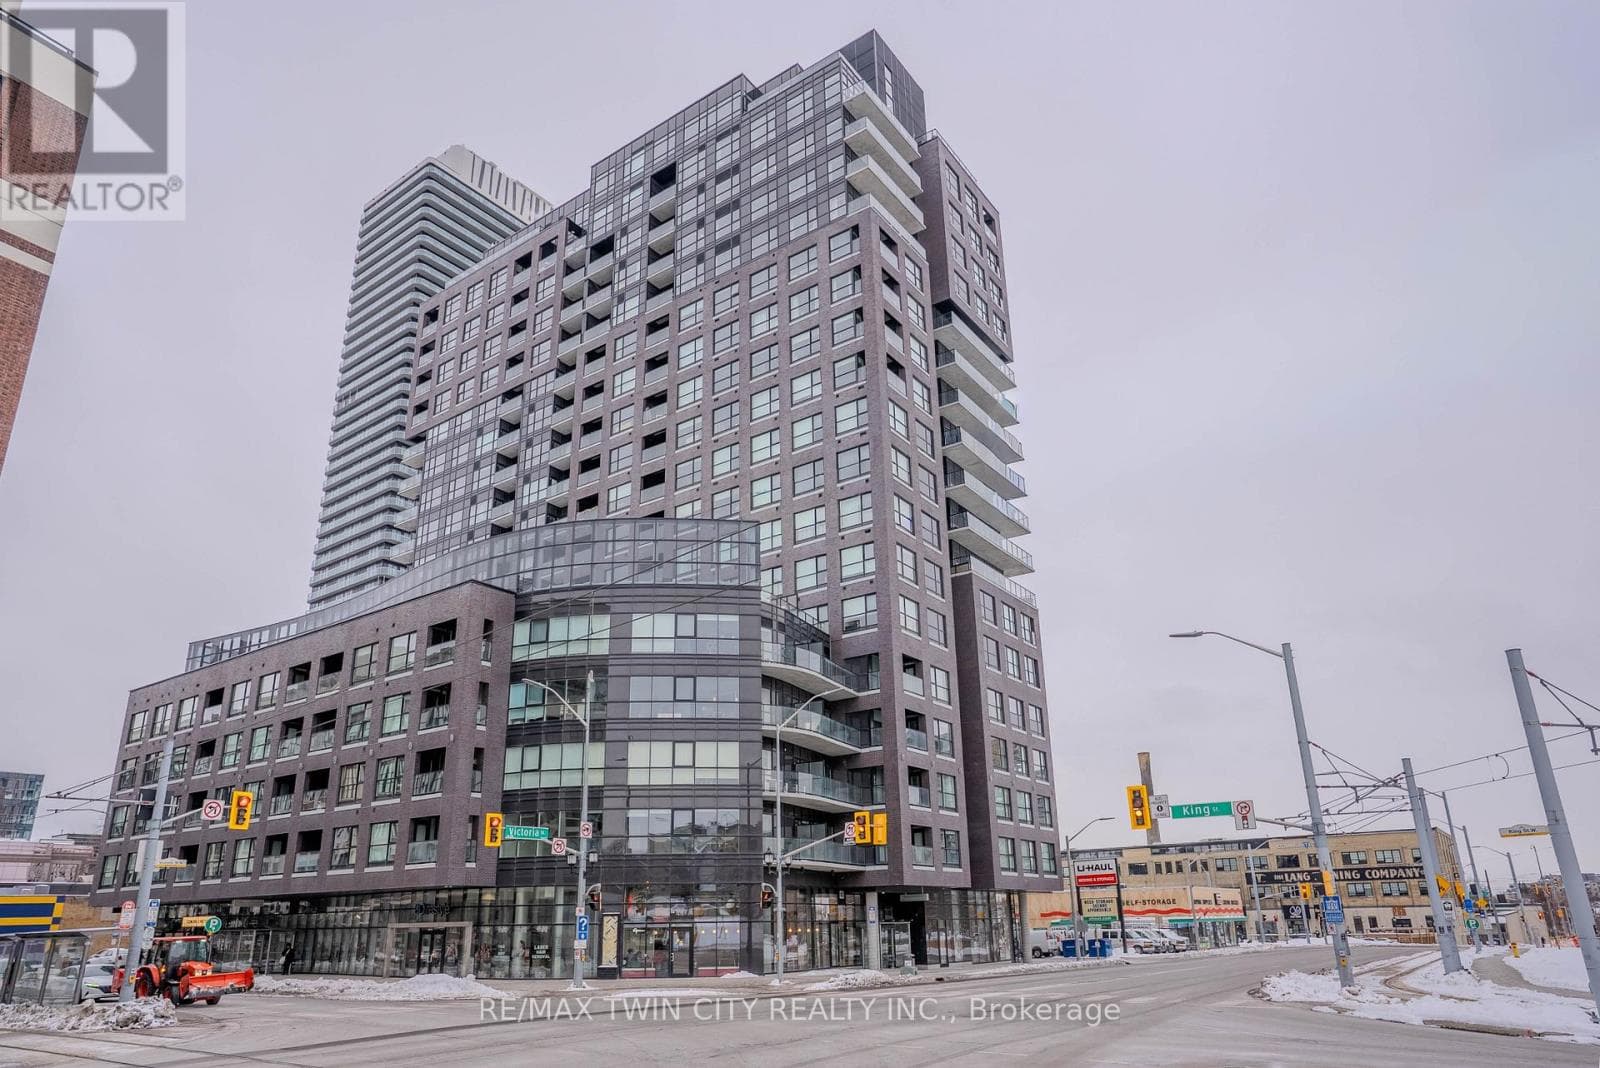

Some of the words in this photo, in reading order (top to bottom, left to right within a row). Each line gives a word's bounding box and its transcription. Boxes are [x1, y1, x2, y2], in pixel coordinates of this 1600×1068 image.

[1182, 804, 1210, 816] King
[508, 827, 539, 836] Victoria
[1077, 863, 1113, 872] U-HAUL
[1284, 872, 1310, 882] LANG
[1364, 867, 1420, 879] COMPANY
